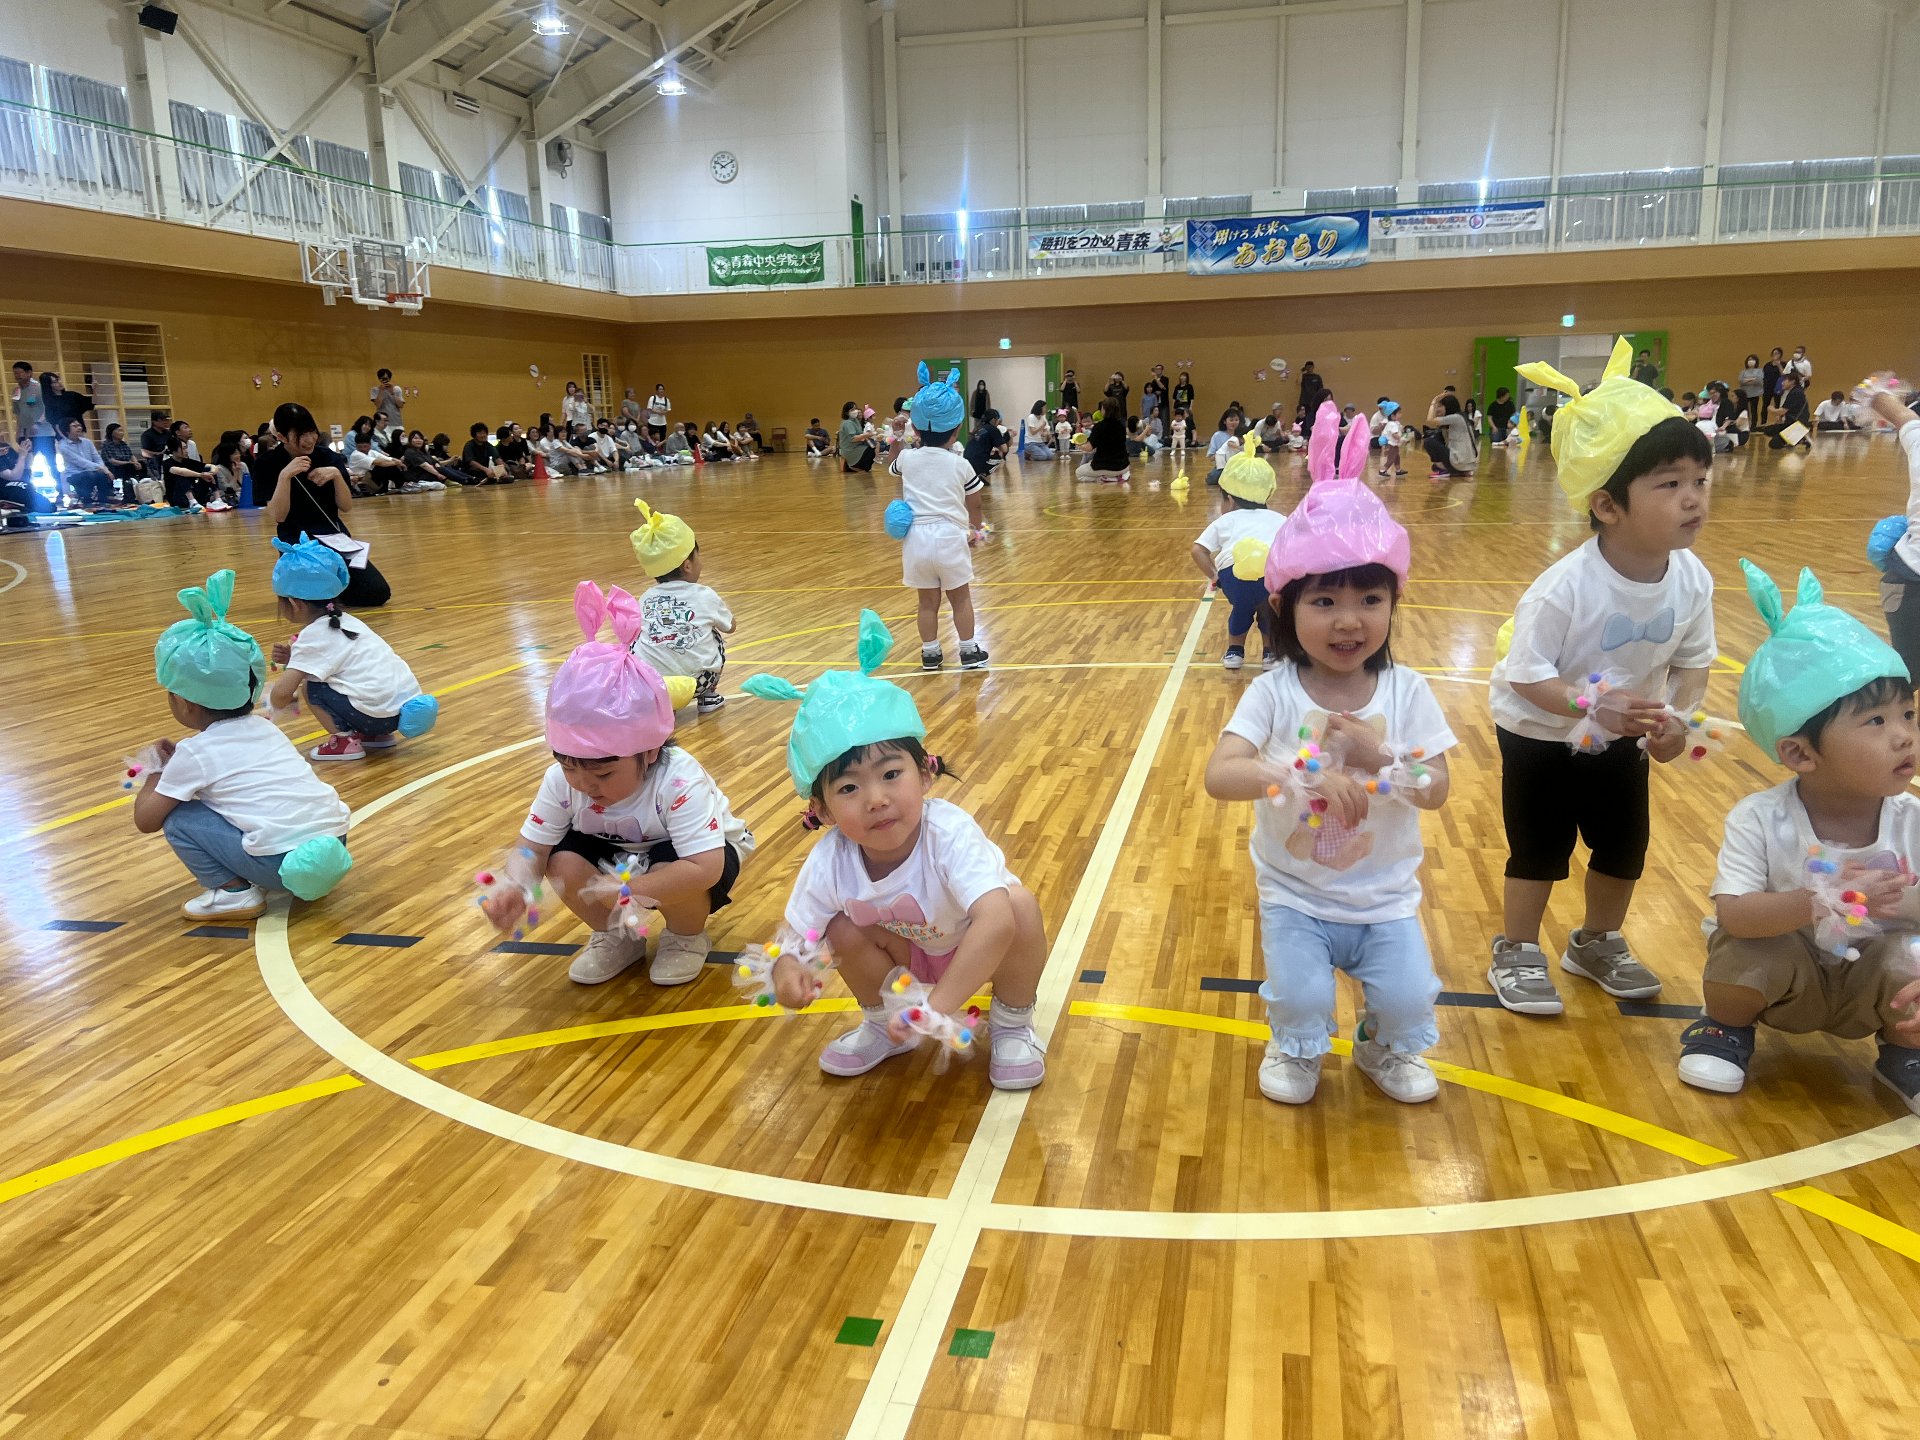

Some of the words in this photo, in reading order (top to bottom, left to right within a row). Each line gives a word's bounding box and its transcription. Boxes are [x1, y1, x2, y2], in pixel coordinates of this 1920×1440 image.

[1233, 229, 1338, 268] あおもり
[731, 252, 821, 268] 青森中央学院大学
[731, 268, 753, 276] Aomori
[753, 268, 770, 276] Chuo
[770, 266, 793, 275] Gakuin
[793, 266, 821, 274] University
